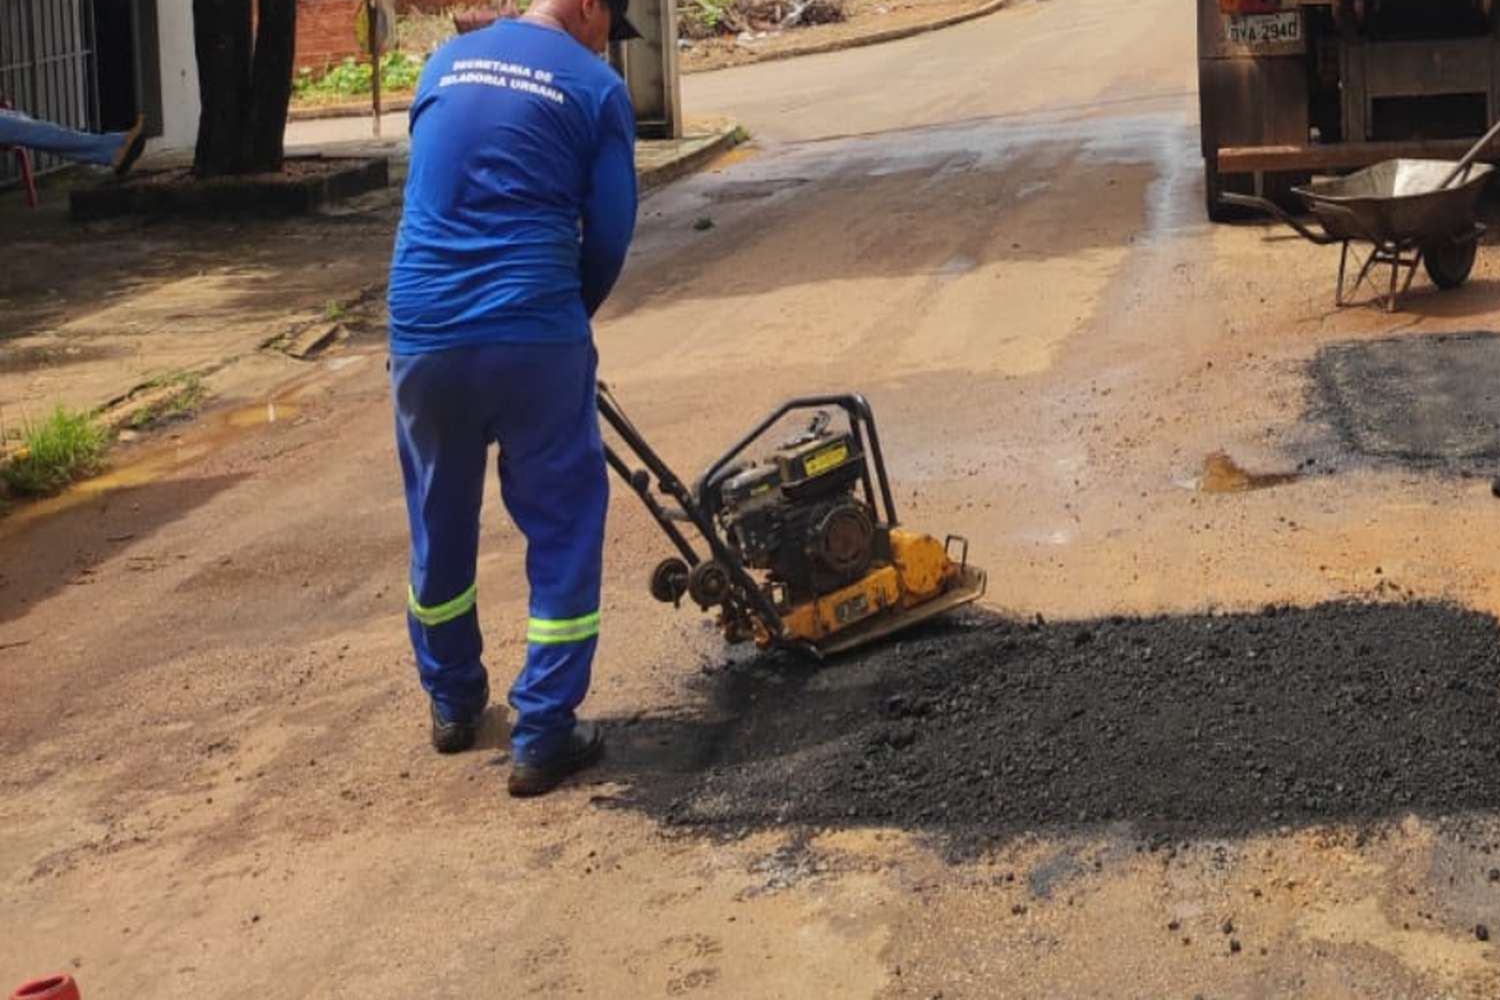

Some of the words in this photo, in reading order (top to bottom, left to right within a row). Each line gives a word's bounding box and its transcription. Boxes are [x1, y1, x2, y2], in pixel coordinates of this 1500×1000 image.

[452, 60, 531, 77] SECRETARIA
[534, 69, 553, 83] DE
[510, 79, 564, 104] URBANA
